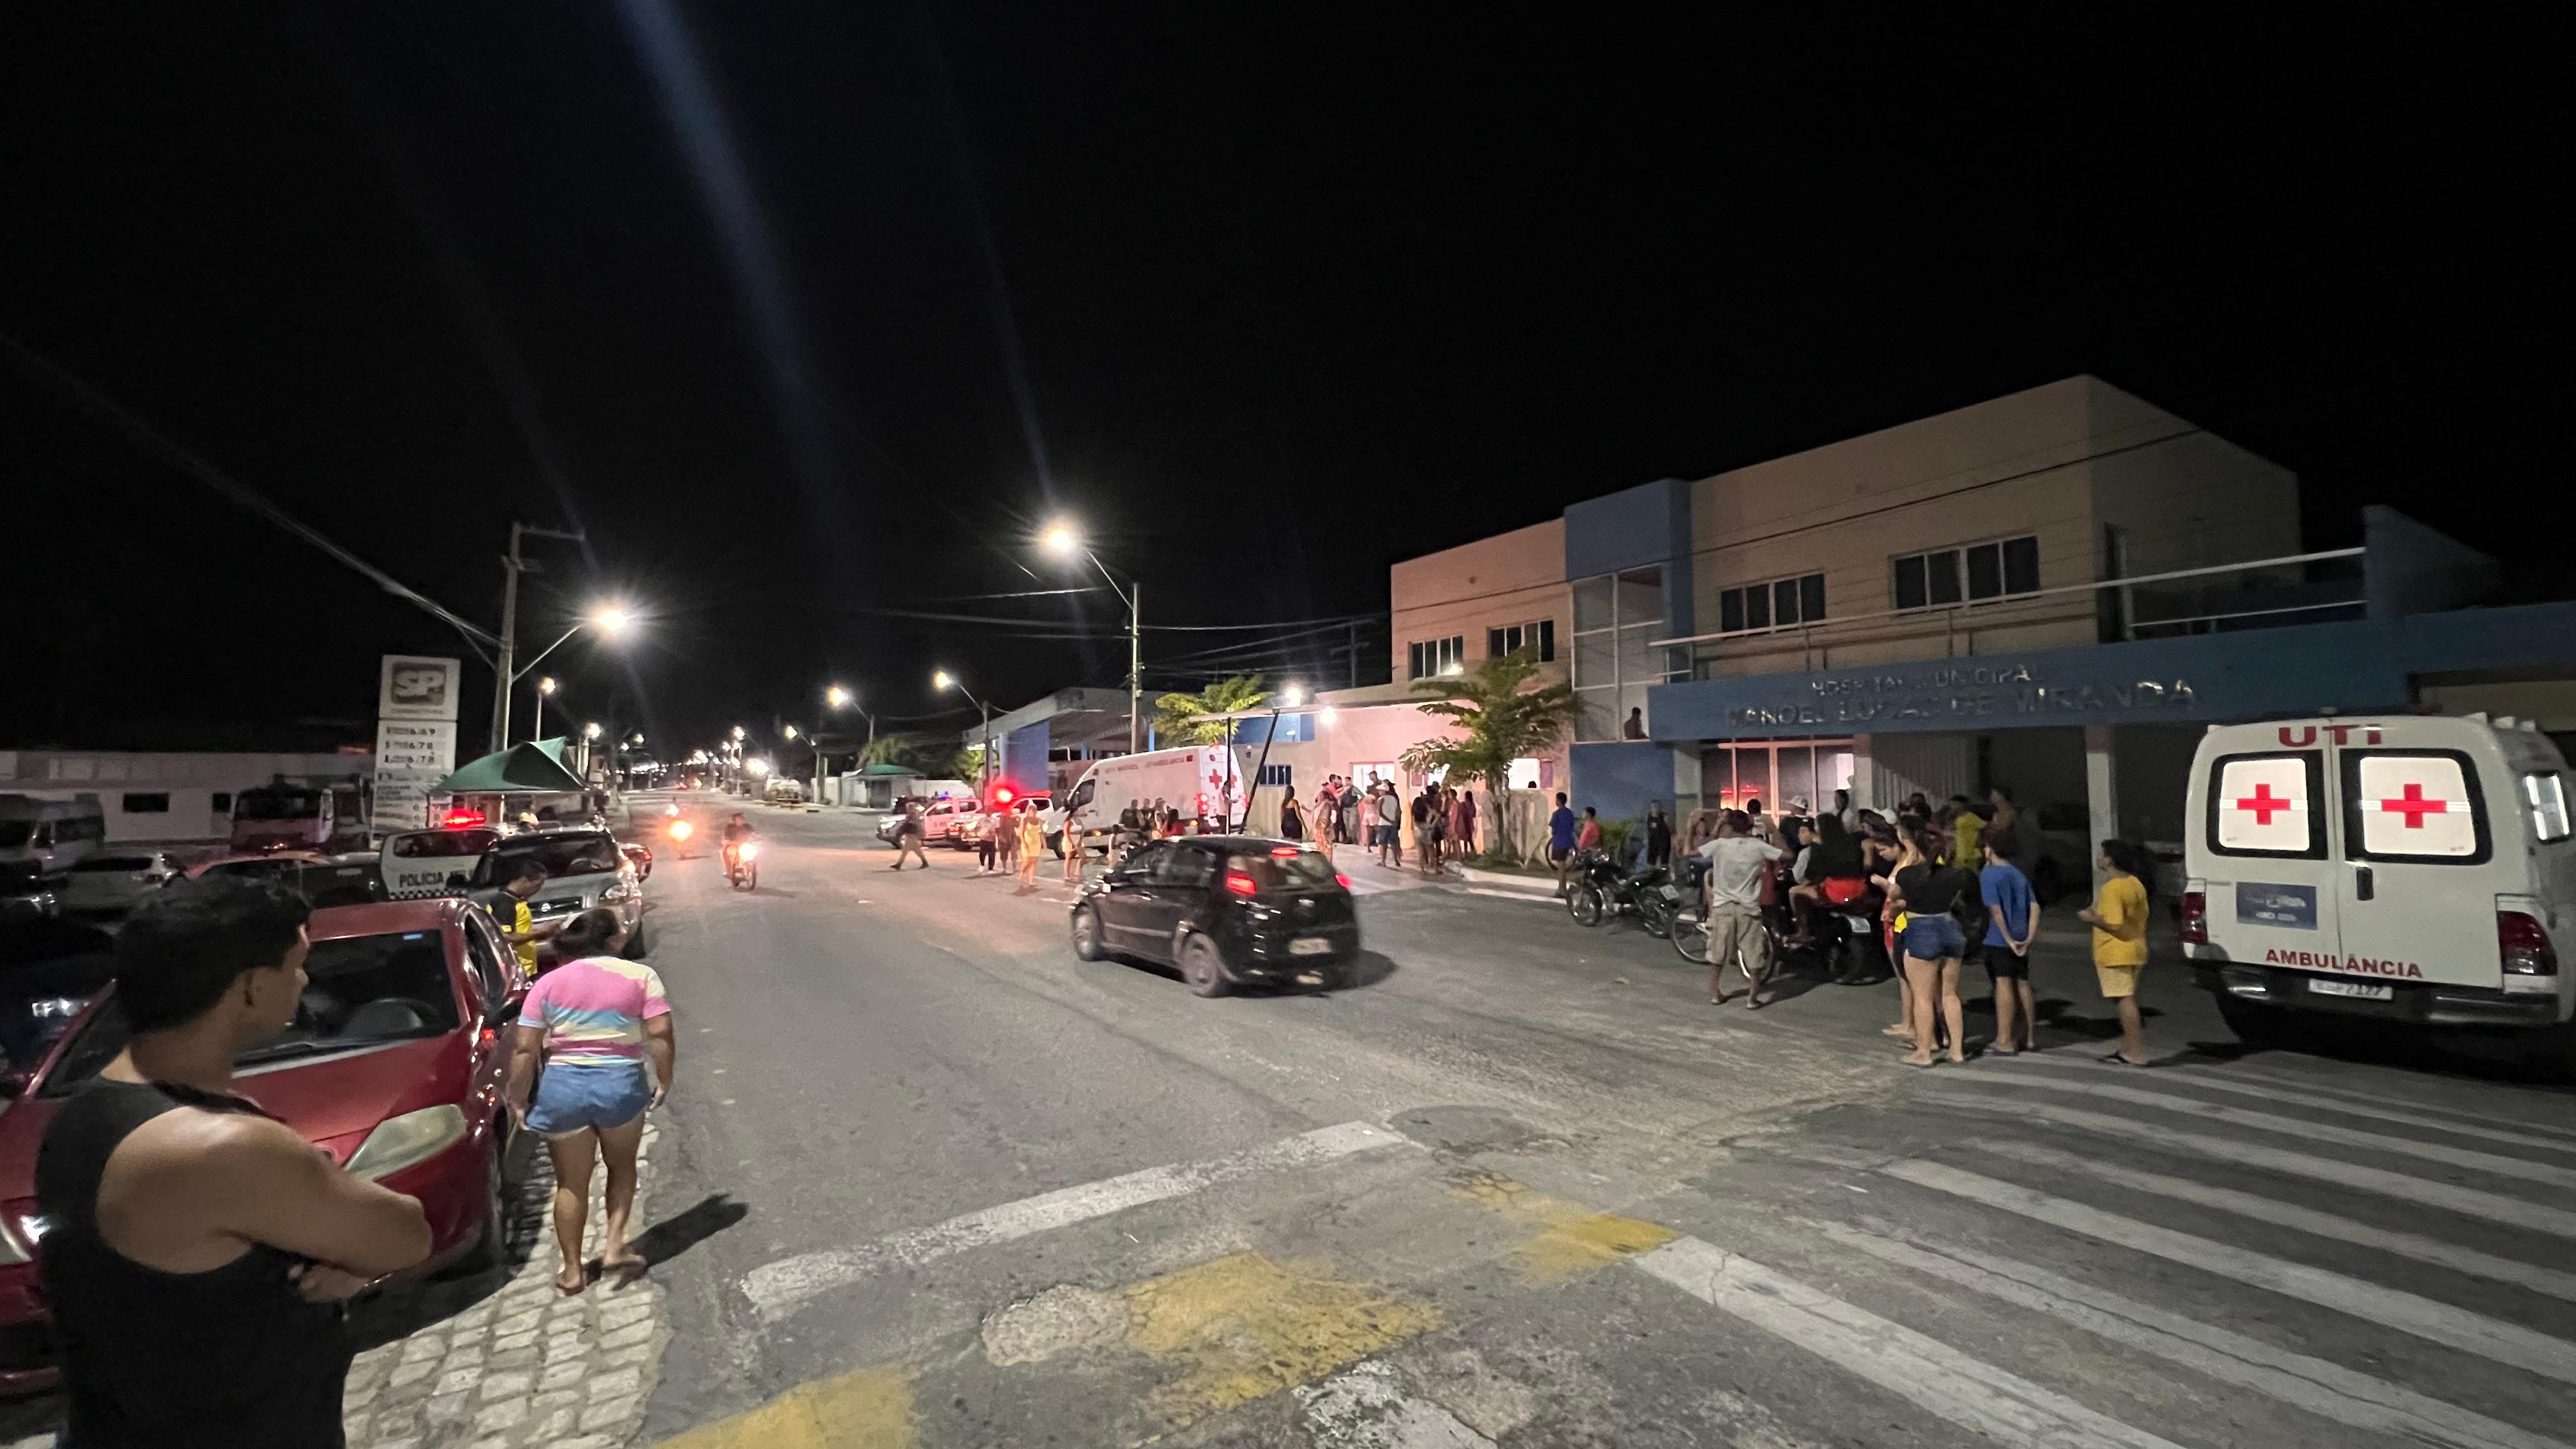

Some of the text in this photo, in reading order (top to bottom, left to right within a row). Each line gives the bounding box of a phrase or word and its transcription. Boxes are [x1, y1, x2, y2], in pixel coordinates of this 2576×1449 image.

[1916, 663, 2042, 689] UNICIPAL
[2278, 724, 2382, 747] UTI
[2266, 949, 2423, 978] AMBULÂNCIA
